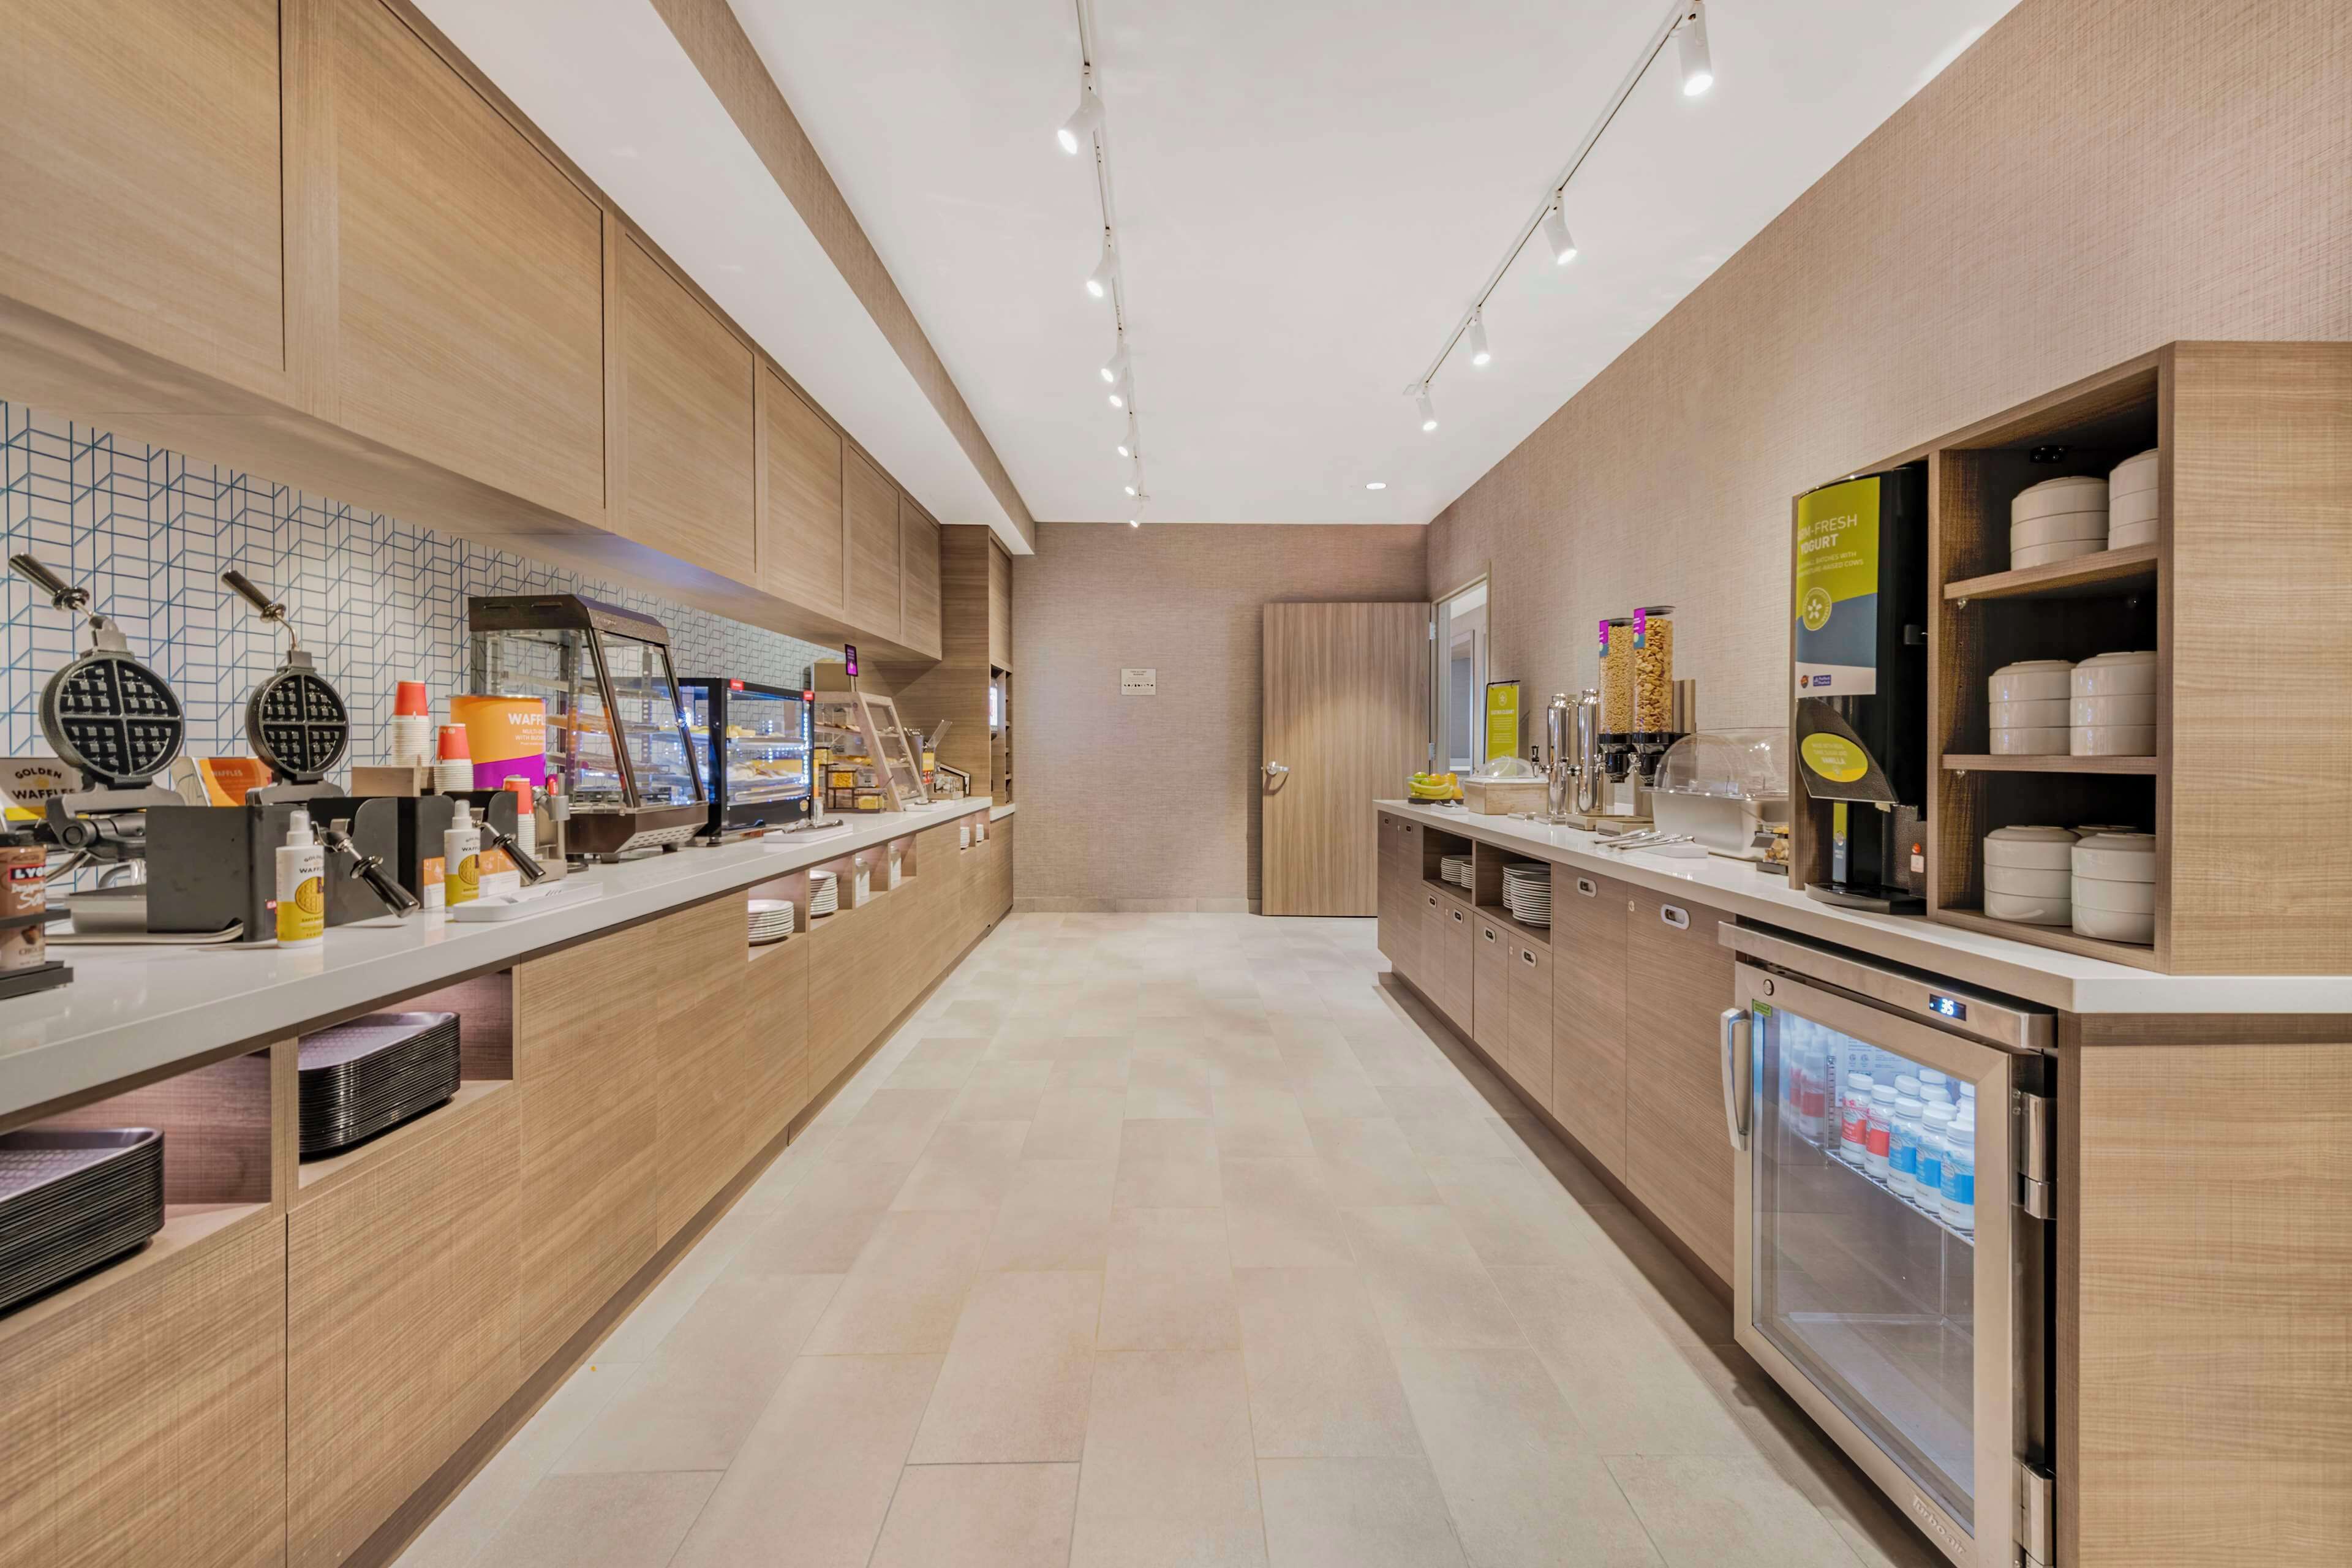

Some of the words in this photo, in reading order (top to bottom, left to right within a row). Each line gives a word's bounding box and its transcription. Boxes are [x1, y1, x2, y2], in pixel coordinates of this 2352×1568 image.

[15, 767, 62, 779] GOLDEN
[1913, 1494, 1946, 1535] Turbo
[1947, 1534, 1967, 1553] air
